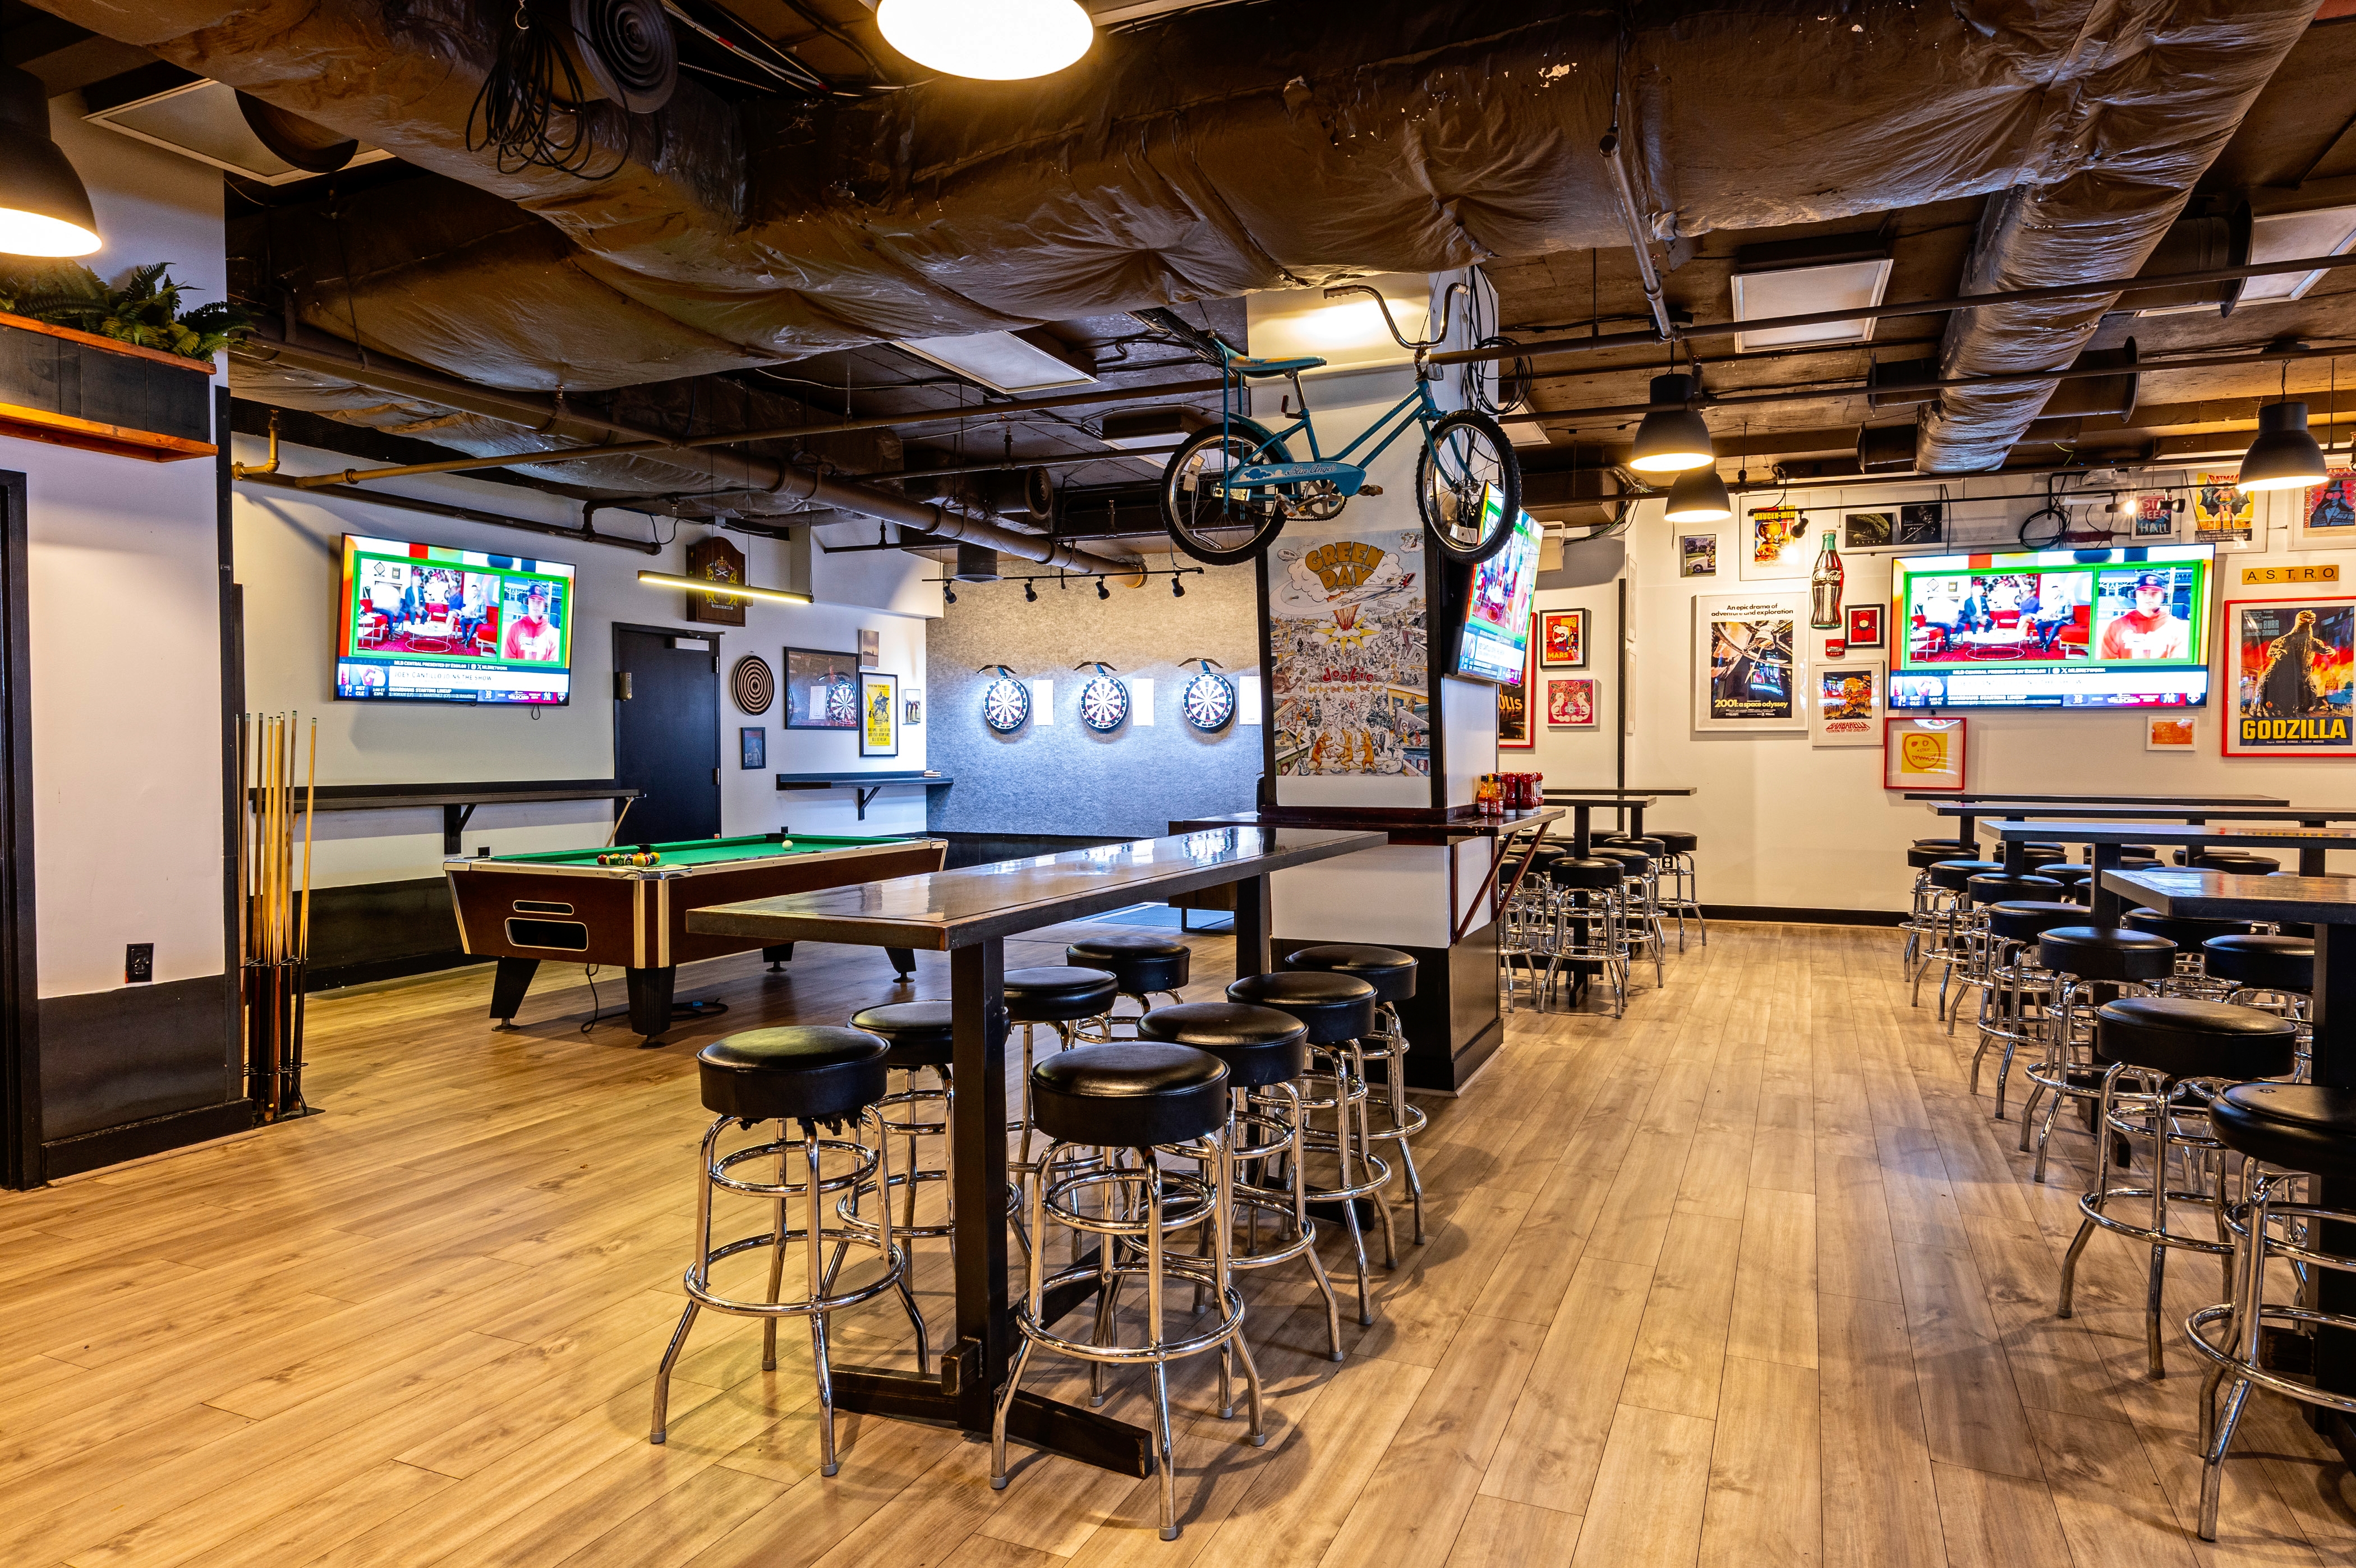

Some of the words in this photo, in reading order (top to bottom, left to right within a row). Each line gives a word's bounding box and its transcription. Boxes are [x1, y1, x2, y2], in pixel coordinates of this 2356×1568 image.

[1285, 465, 1308, 476] Blue
[1309, 463, 1337, 474] Angel
[2208, 474, 2239, 484] BATMAN
[1755, 512, 1794, 520] SAUCER-MEN
[2138, 510, 2169, 521] BEER
[2140, 523, 2169, 534] HALL
[1305, 541, 1386, 571] GREEN
[1319, 565, 1374, 589] DAY
[2247, 568, 2334, 581] ASTRO
[2263, 620, 2279, 629] BURR
[1322, 667, 1374, 683] dookie
[1499, 694, 1523, 710] OLIS
[2243, 719, 2347, 739] GODZILLA
